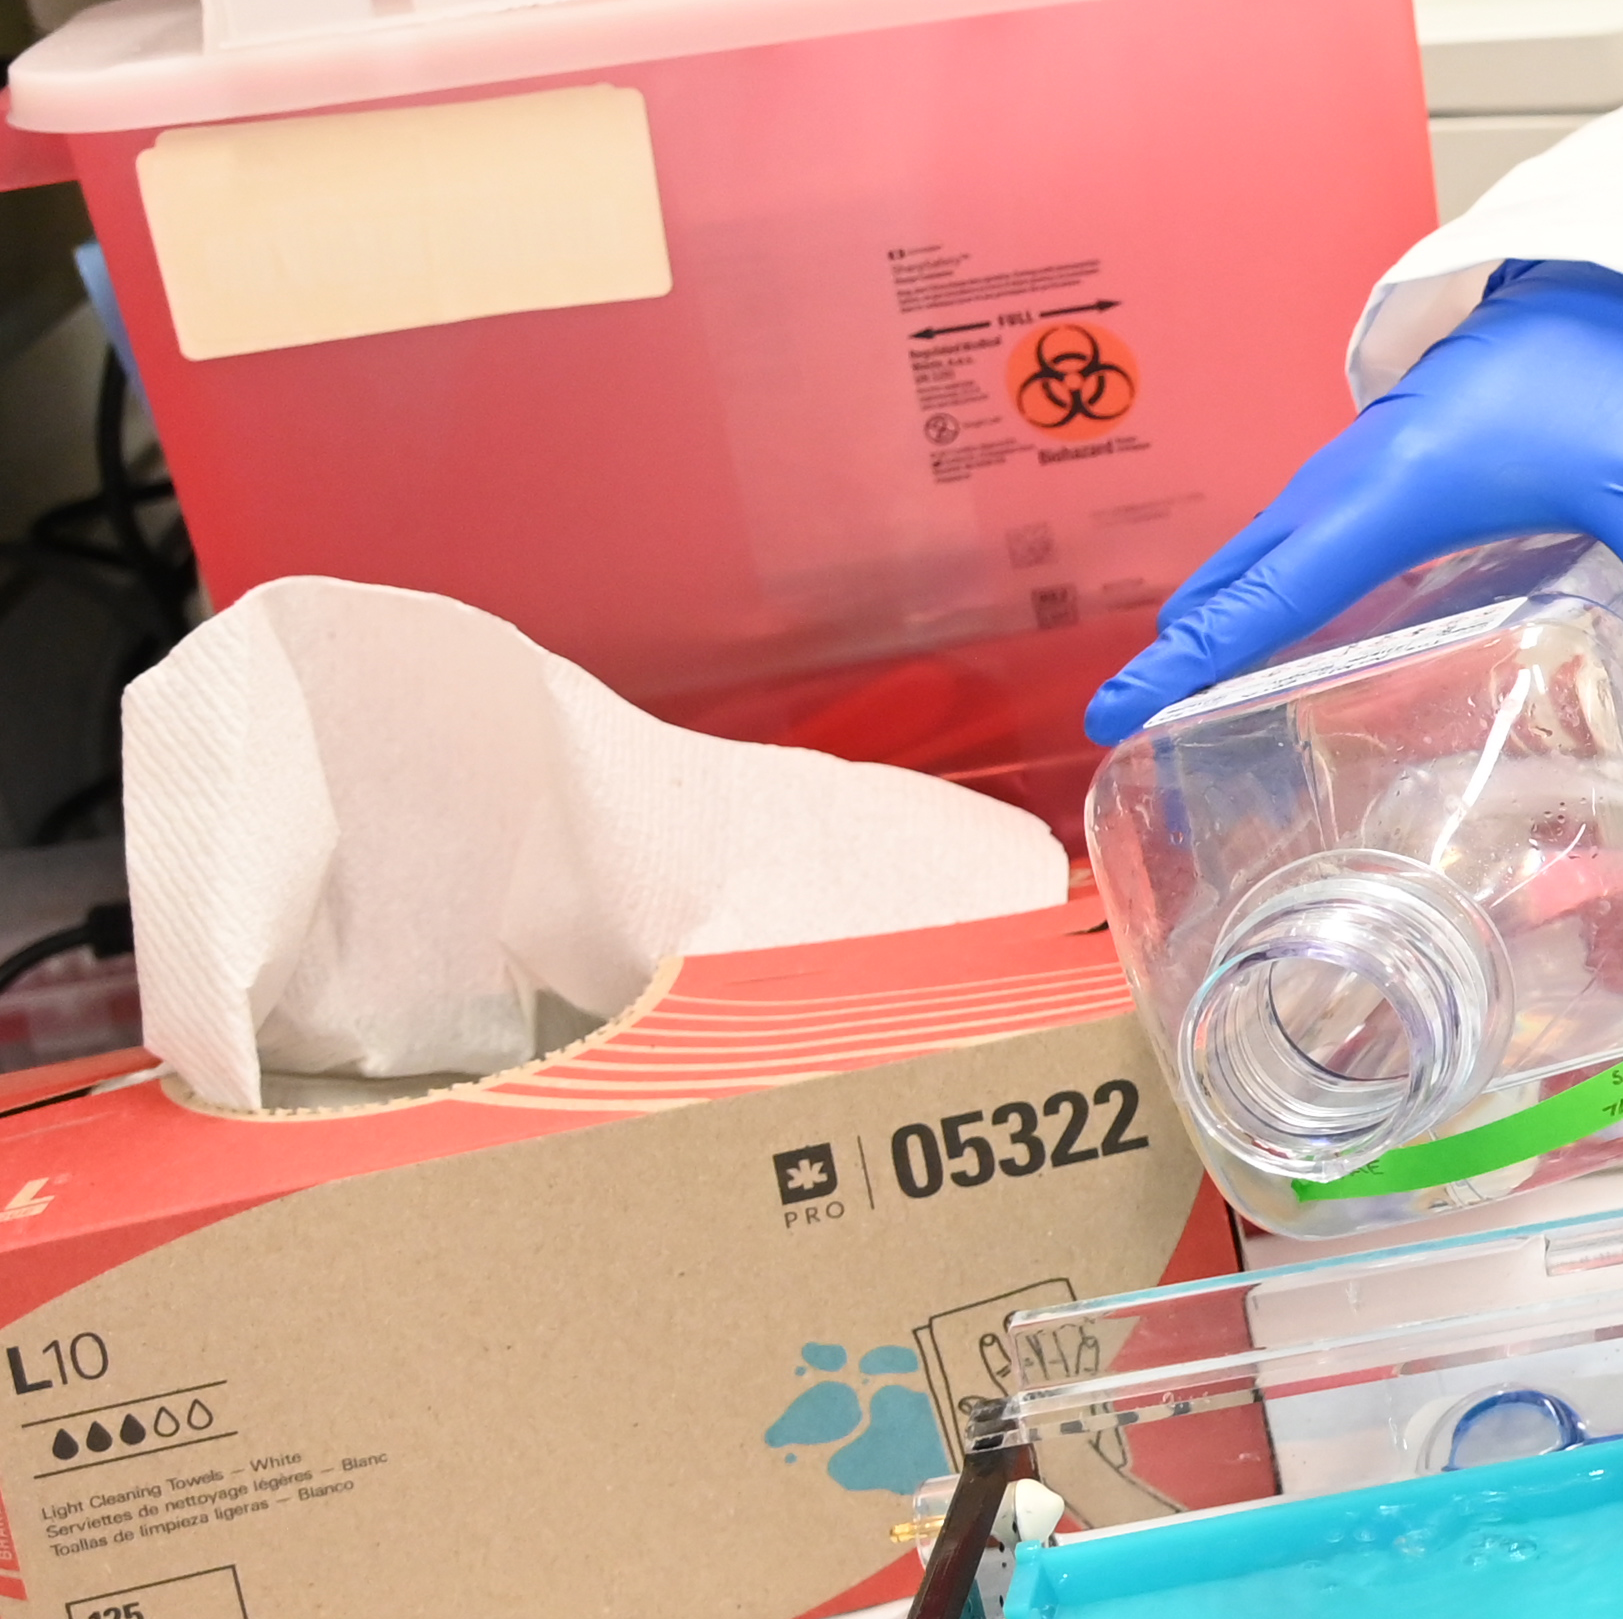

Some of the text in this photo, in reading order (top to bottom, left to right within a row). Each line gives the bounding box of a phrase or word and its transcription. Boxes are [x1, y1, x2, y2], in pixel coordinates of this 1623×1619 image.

[998, 310, 1035, 328] FULL
[1038, 440, 1113, 466] Biohazard
[891, 1078, 1149, 1200] 05322
[783, 1199, 846, 1230] PRO
[6, 1330, 110, 1395] L10
[41, 1452, 303, 1523] Light Cleaning Towels White
[46, 1451, 389, 1539] Serviettes de nettoyage légères Blanc
[50, 1477, 354, 1558] Toallas de limpieza ligeras Blanco
